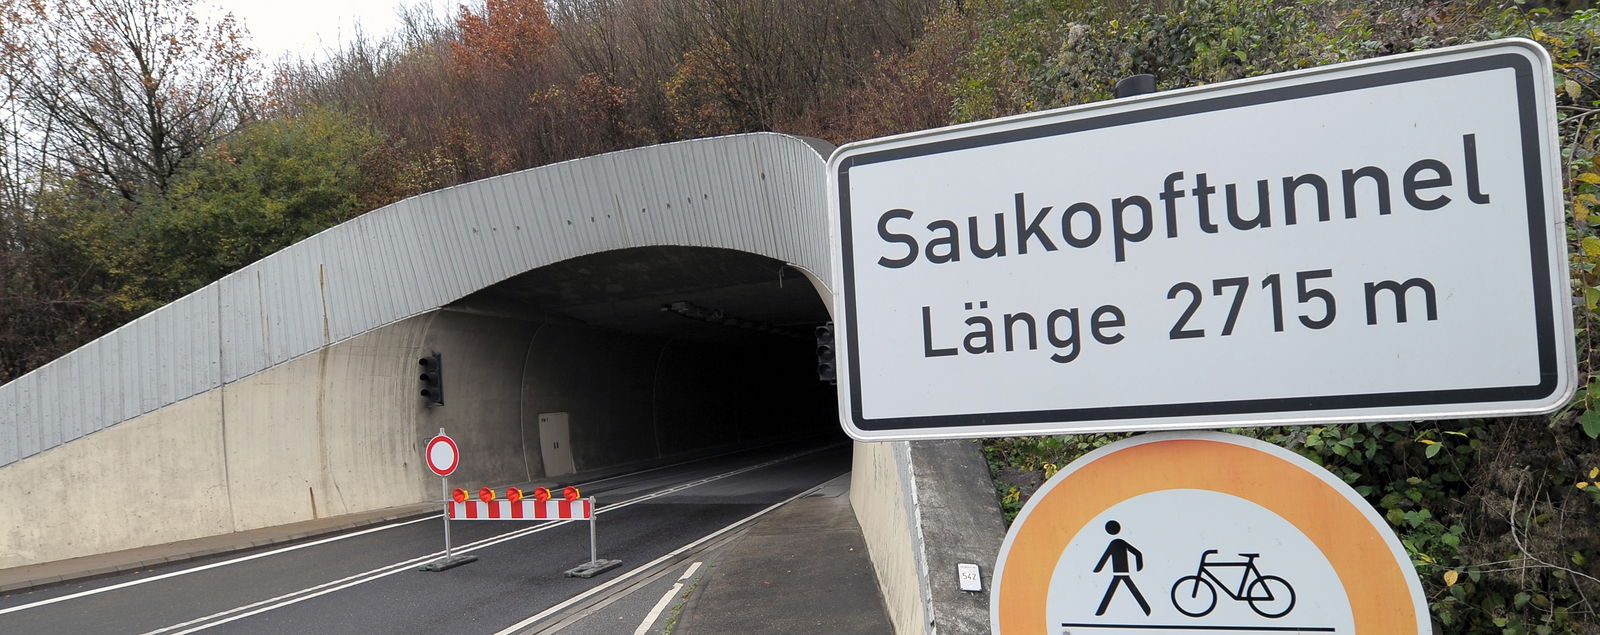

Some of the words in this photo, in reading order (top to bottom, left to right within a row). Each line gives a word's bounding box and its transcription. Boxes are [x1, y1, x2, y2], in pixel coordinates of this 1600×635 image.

[877, 133, 1490, 269] Saukopftunnel
[922, 301, 1126, 364] Länge
[1166, 268, 1337, 340] 2715
[1364, 277, 1438, 326] m
[962, 572, 977, 581] 542
